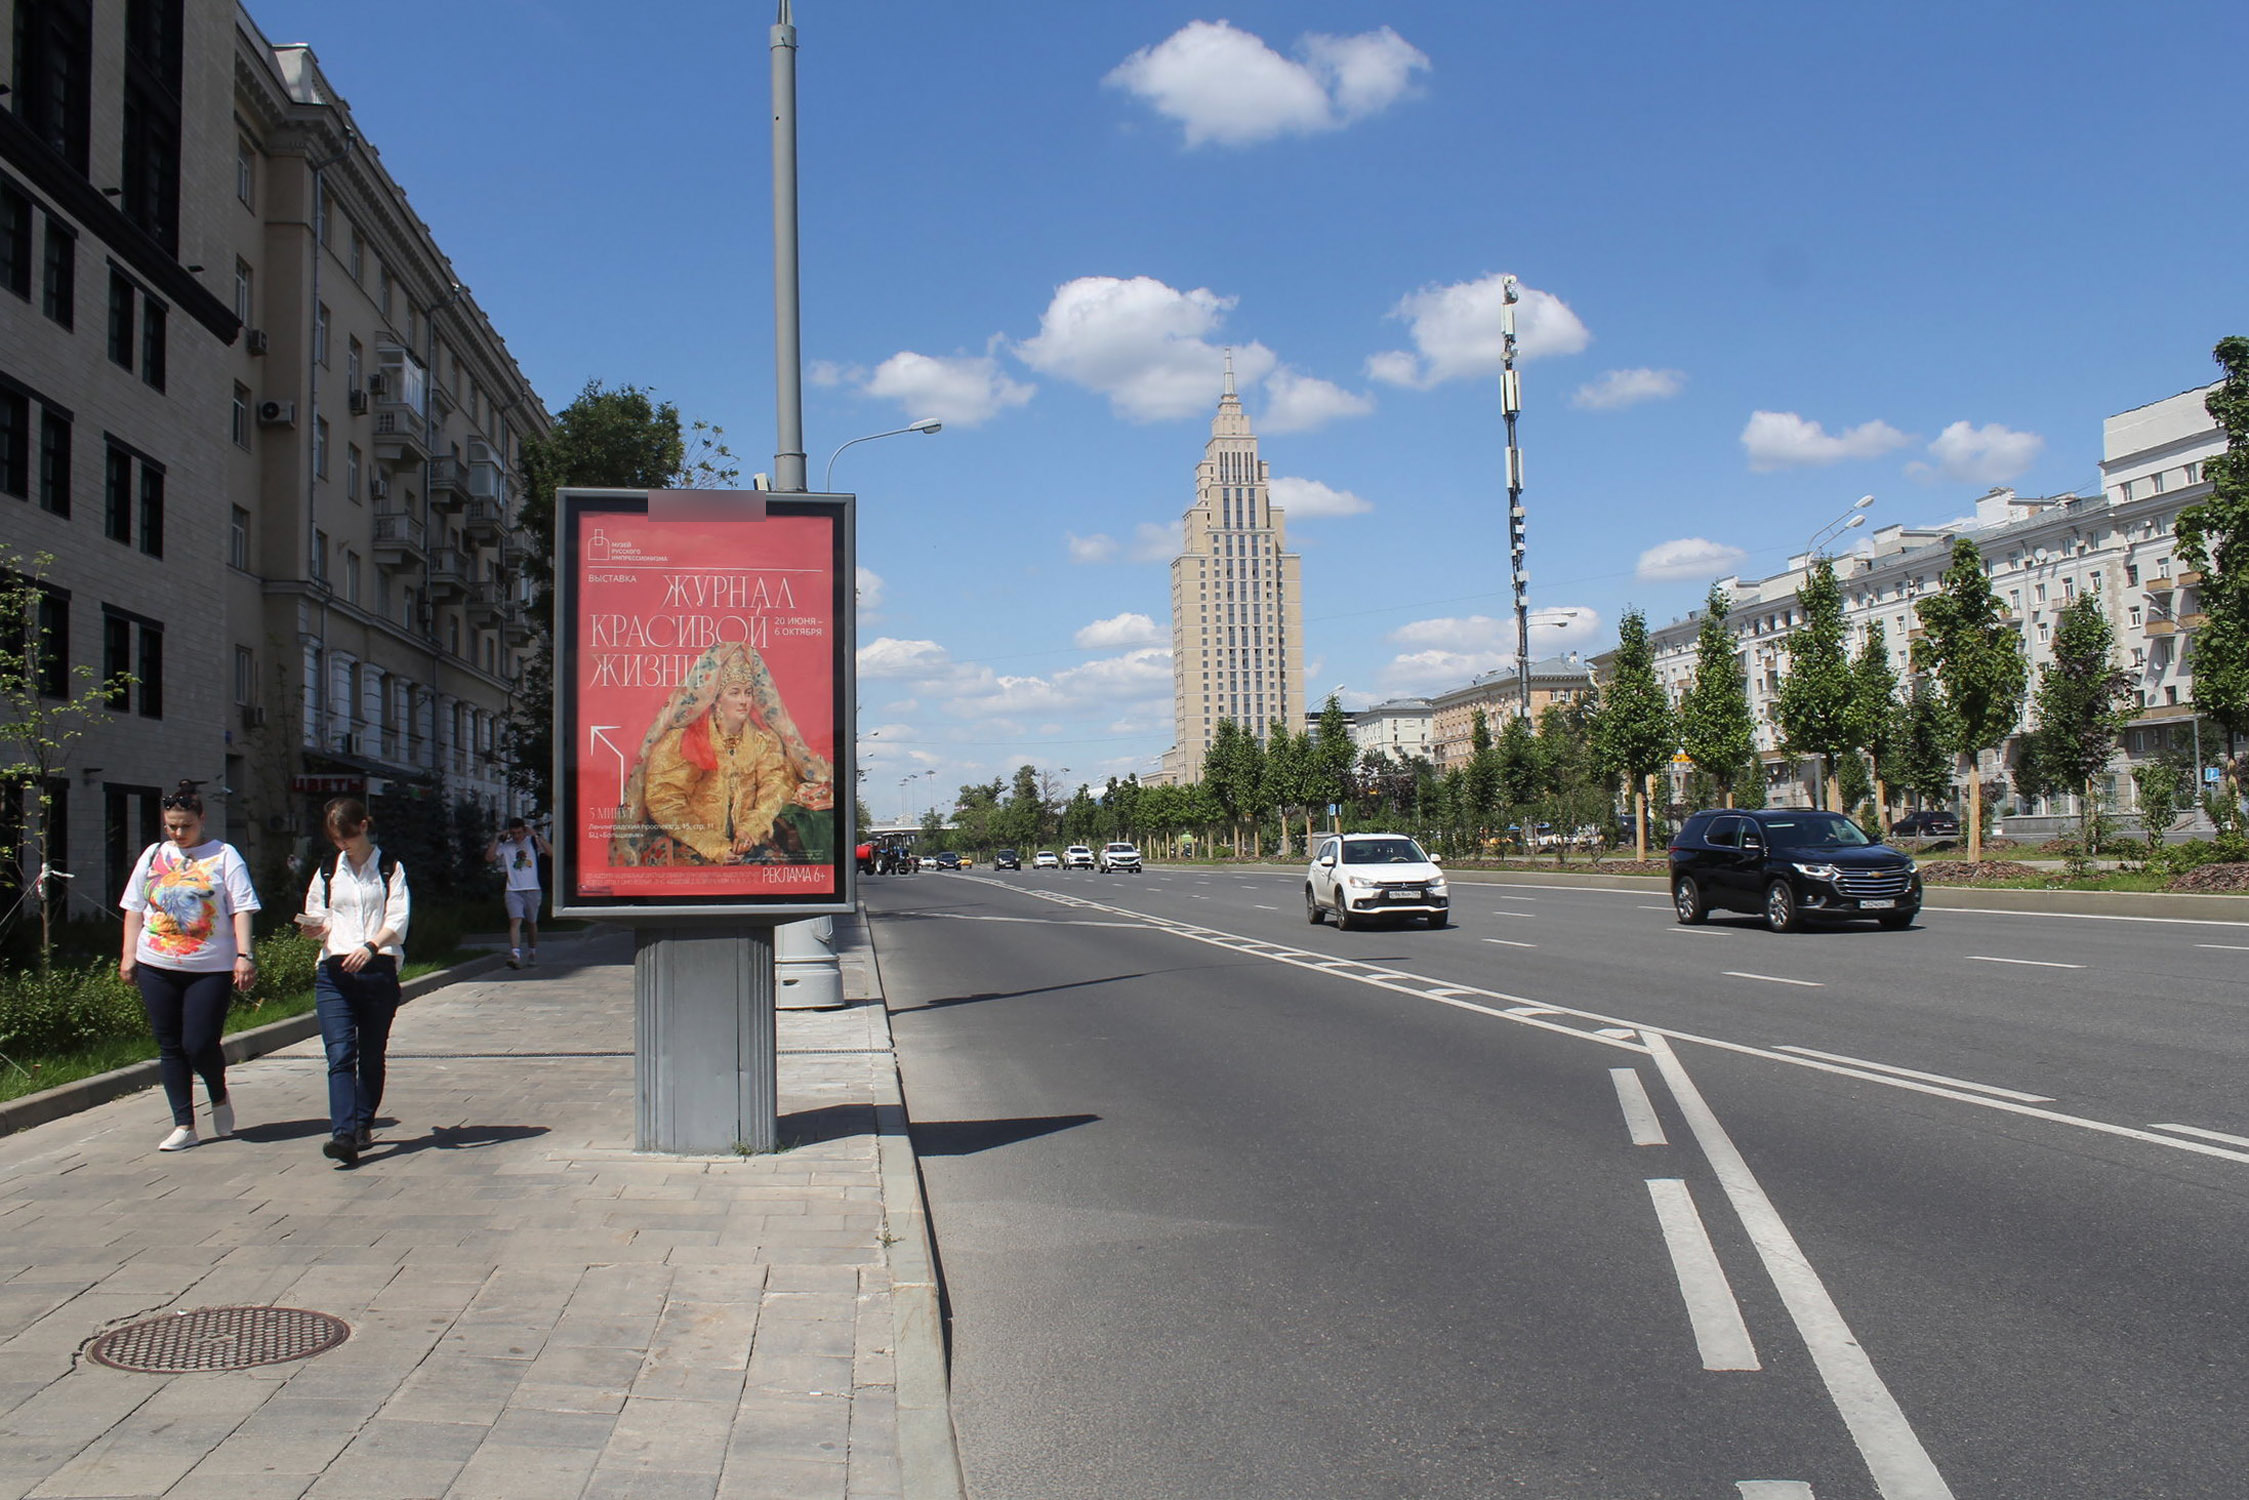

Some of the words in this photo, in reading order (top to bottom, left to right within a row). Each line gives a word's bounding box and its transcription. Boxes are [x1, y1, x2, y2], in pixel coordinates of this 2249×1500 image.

[588, 574, 637, 583] ВЫСТАВКА
[660, 574, 796, 609] ЖУРНАЛ
[774, 616, 785, 625] 20
[787, 616, 816, 625] ИЮНЯ
[589, 608, 769, 649] КРАСИВОЙ
[774, 628, 780, 636] 6
[782, 628, 822, 636] ОКТЯБРЯ
[588, 653, 704, 687] ЖИЗНИ
[292, 777, 366, 792] ЦВЕТЫ
[589, 807, 596, 819] 5
[597, 807, 635, 819] МИНУТ
[763, 866, 812, 883] РЕКЛАМА
[814, 866, 826, 882] 6+
